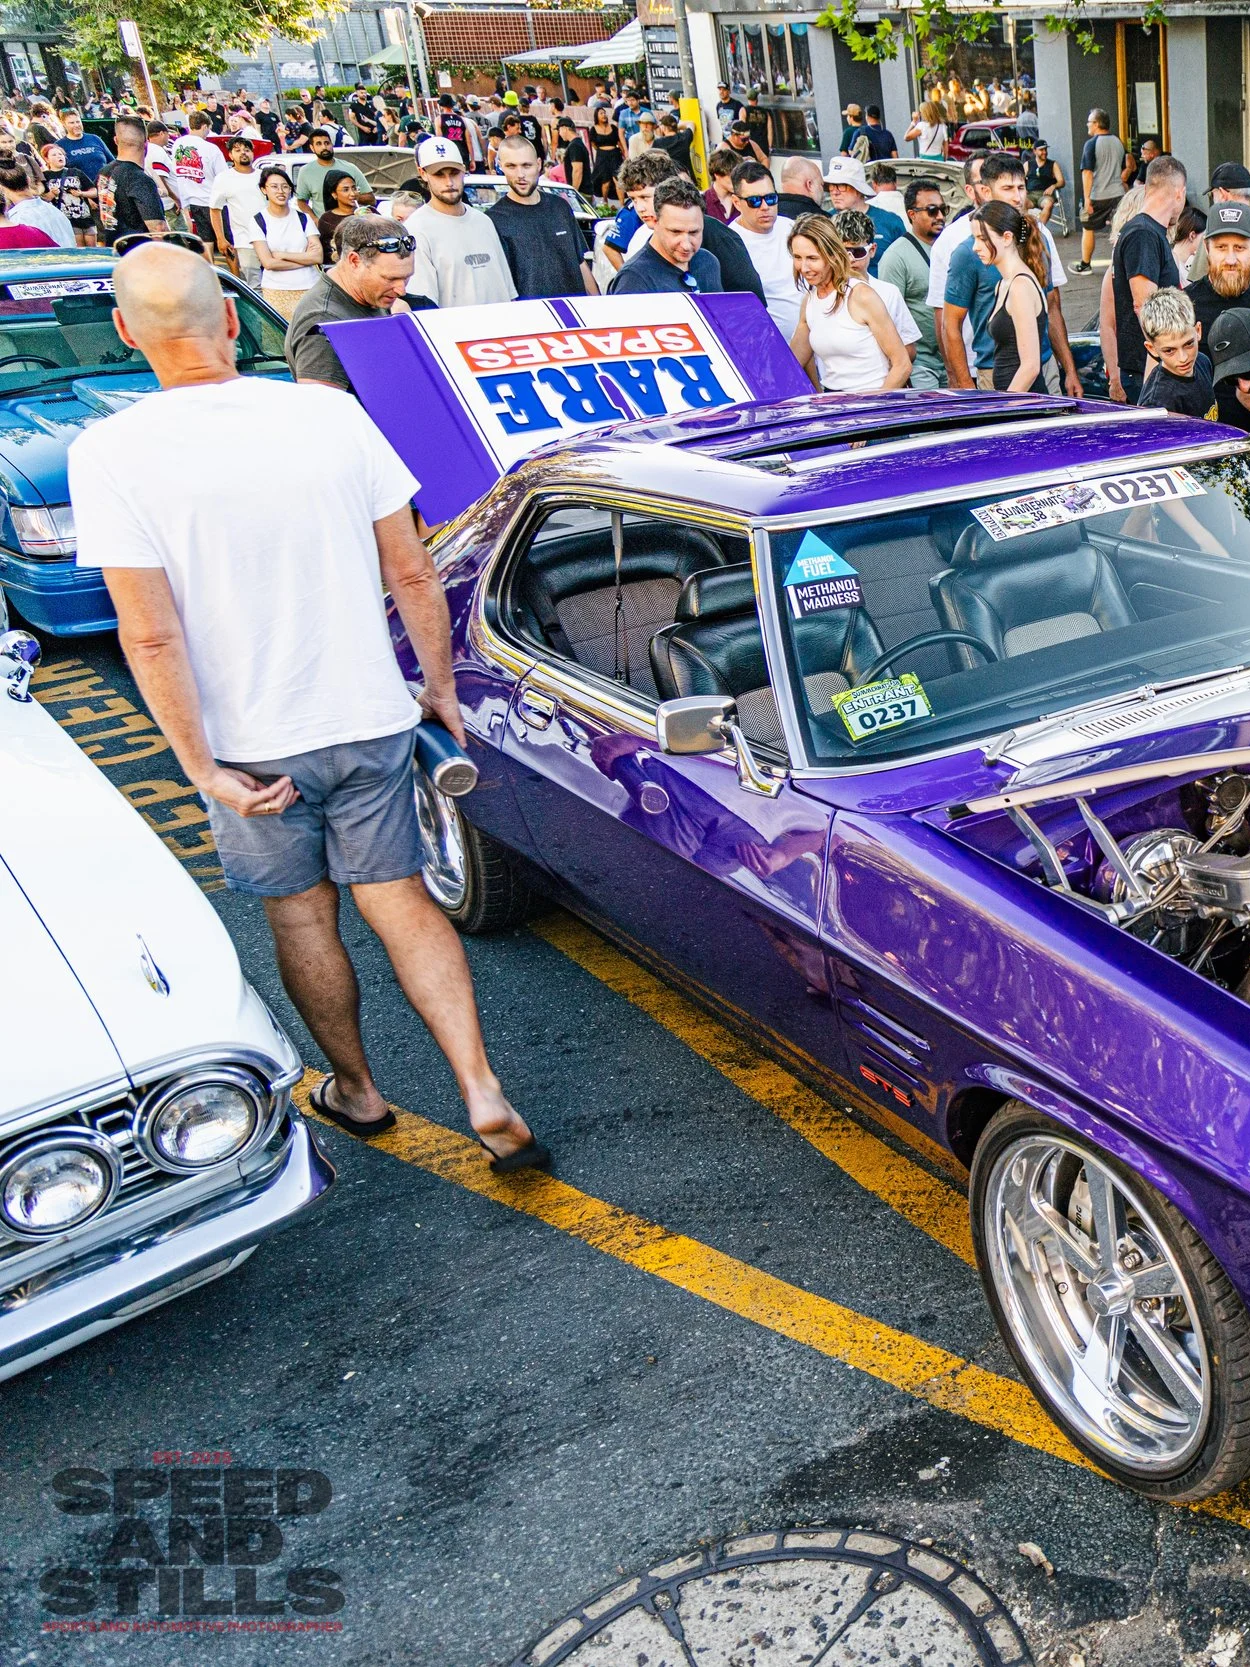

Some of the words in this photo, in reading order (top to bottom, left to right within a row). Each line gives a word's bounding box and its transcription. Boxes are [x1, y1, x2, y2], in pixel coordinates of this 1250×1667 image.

[648, 42, 662, 53] LIVE
[663, 42, 678, 53] MUSI
[651, 66, 665, 77] LIVE
[667, 66, 681, 78] MUSI
[447, 127, 464, 140] 22
[466, 327, 695, 369] SPARES
[475, 354, 736, 437] RARE
[1099, 472, 1178, 505] 0237
[994, 493, 1067, 520] SUMMERNATS
[1030, 510, 1048, 522] 38
[796, 554, 836, 568] METHANOL
[802, 562, 836, 578] FUEL
[796, 578, 861, 600] METHANOL
[803, 590, 860, 611] MADNESS
[841, 683, 916, 715] ENTRANT
[858, 699, 916, 730] 0237
[859, 1064, 911, 1109] GTS
